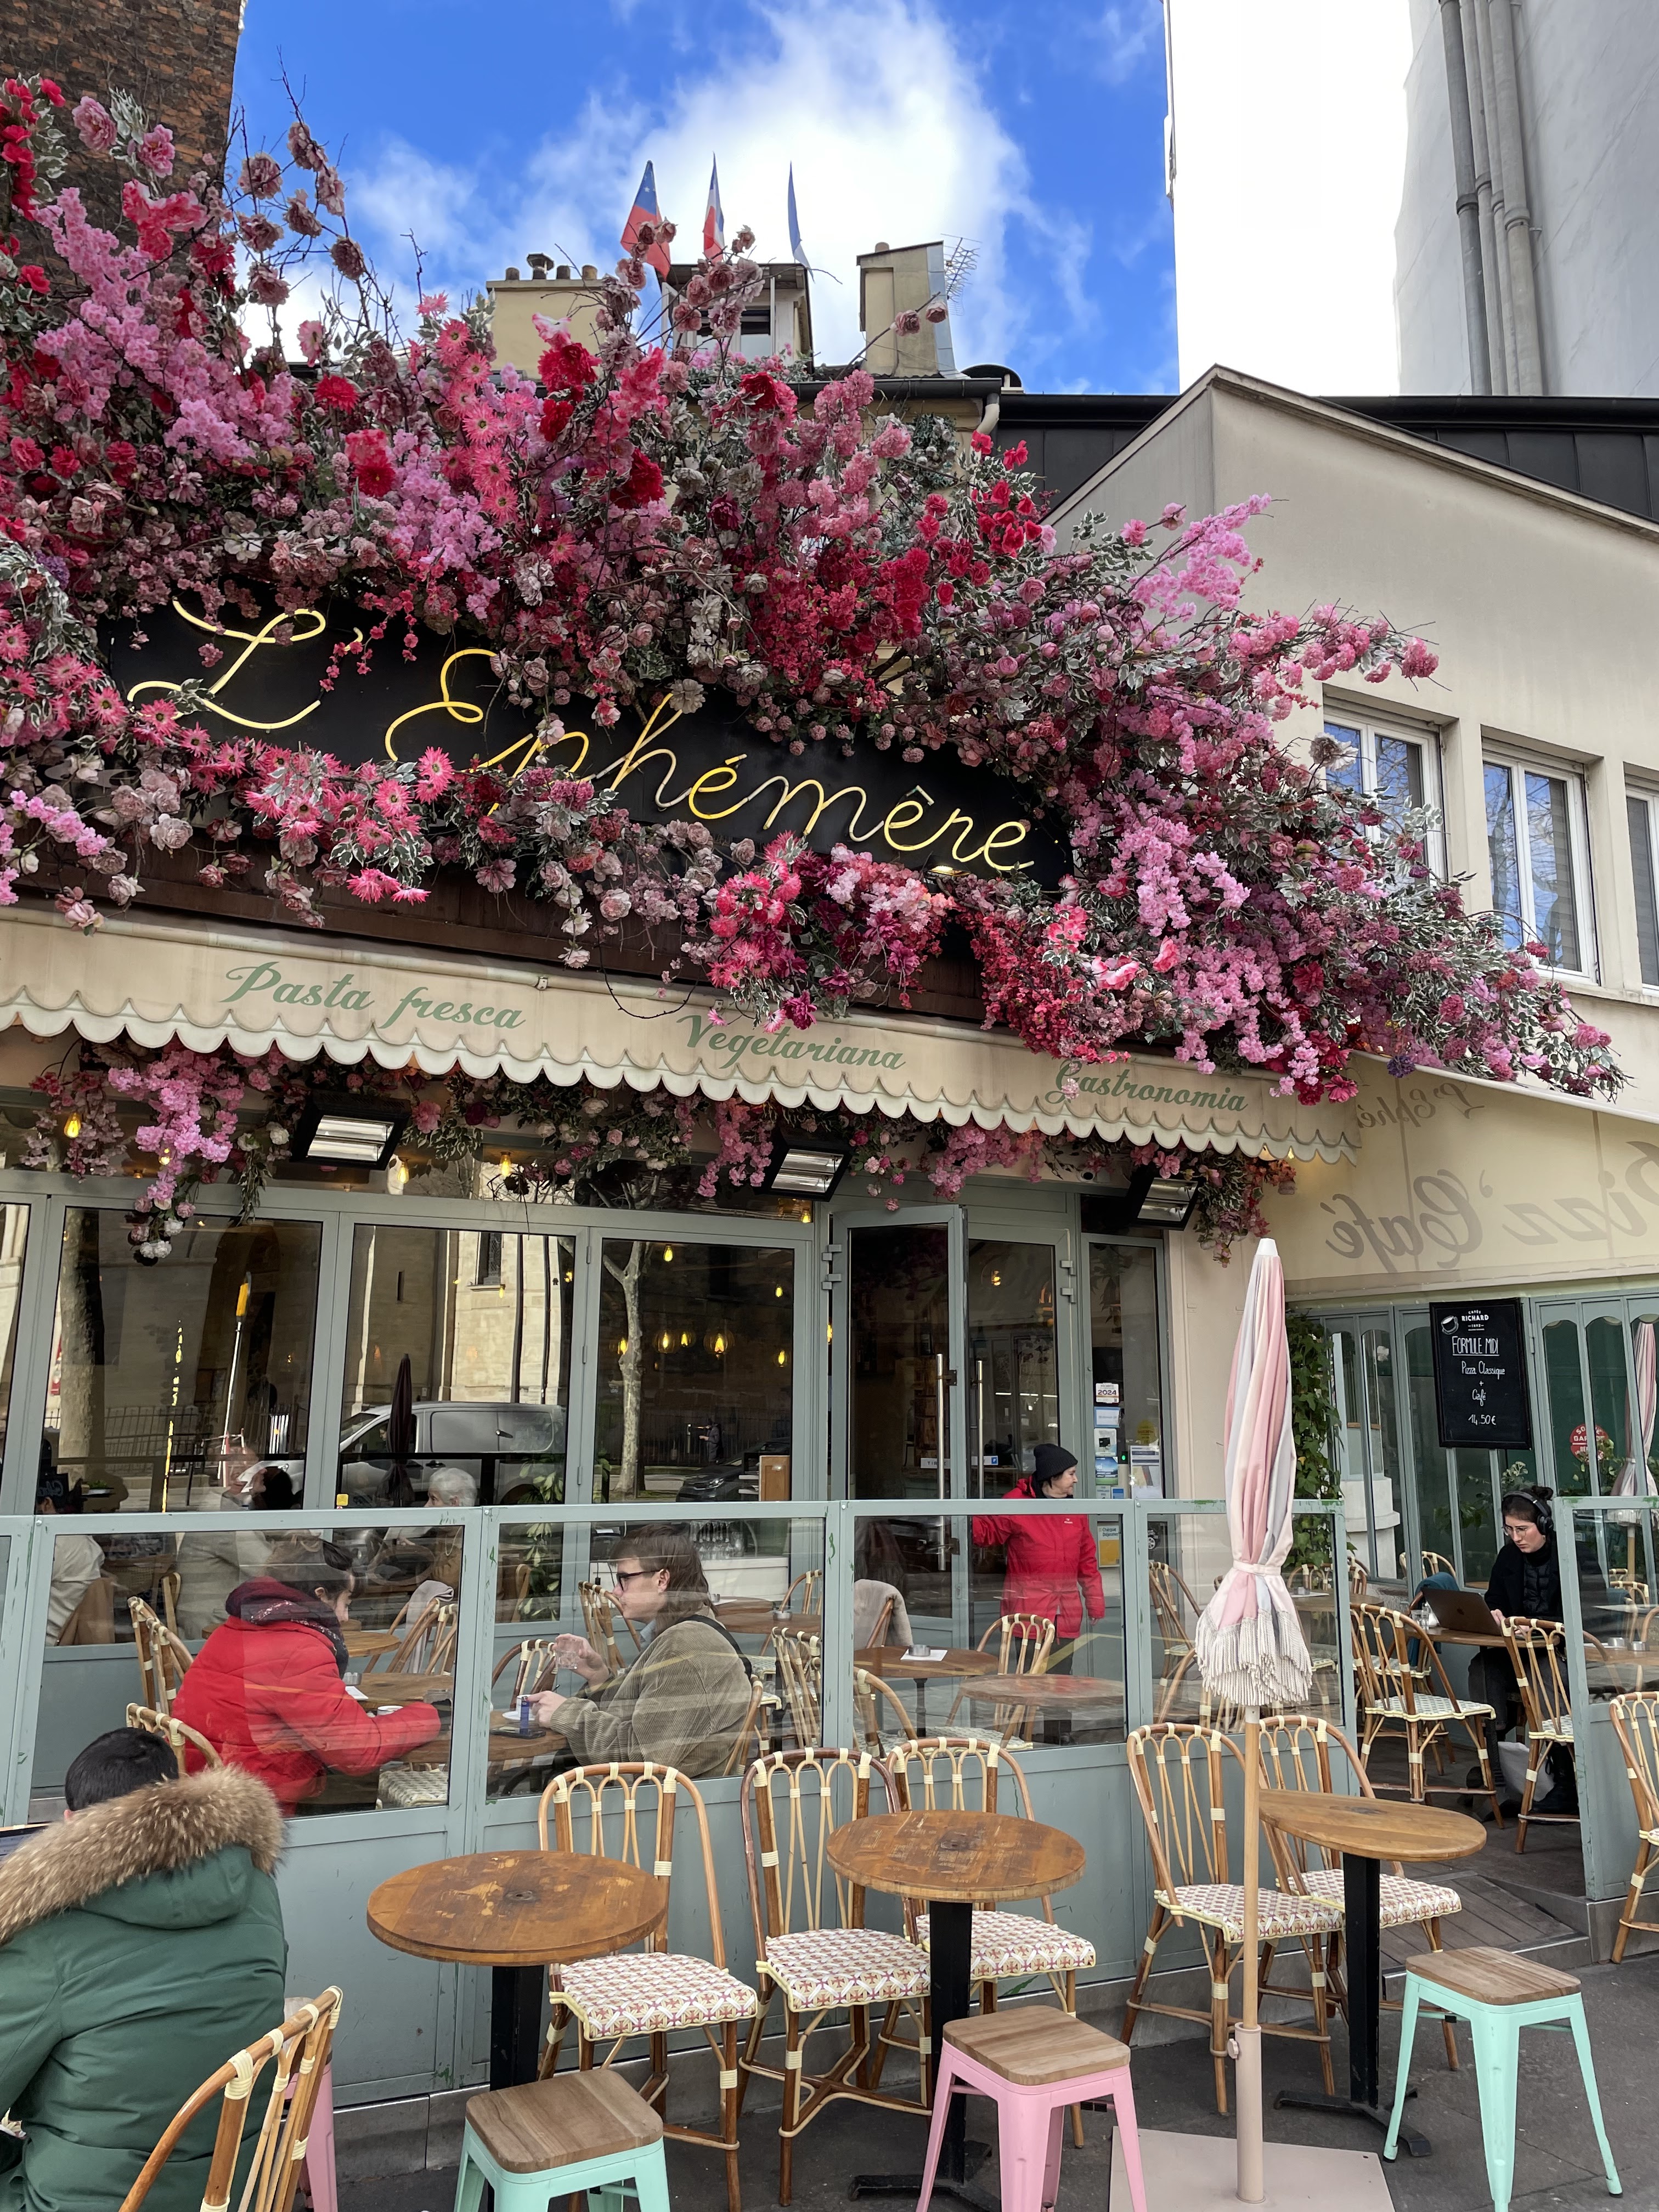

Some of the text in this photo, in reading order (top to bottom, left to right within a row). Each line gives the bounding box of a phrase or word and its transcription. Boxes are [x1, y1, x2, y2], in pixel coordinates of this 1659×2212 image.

[218, 961, 526, 1029] Pasta fresca
[676, 1015, 906, 1070] Vegetariana
[1045, 1059, 1249, 1112] Gastronomia
[1452, 1335, 1483, 1354] FORMULE
[1462, 1361, 1505, 1380] Pizza Classique
[1472, 1389, 1487, 1407] Café
